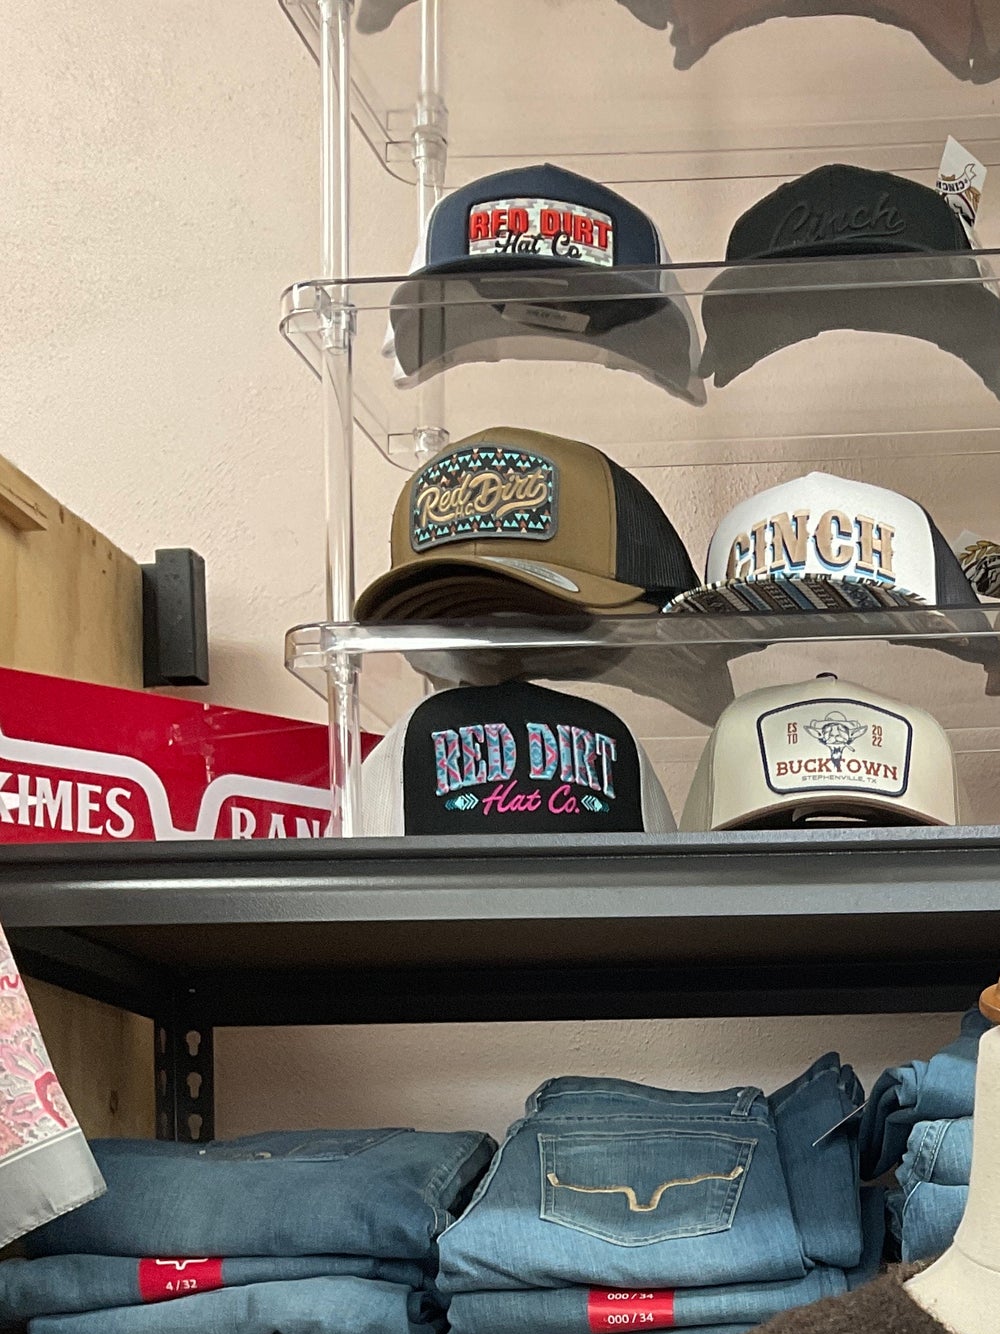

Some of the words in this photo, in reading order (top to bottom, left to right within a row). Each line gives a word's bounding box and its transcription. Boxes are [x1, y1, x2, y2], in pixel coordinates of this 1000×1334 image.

[470, 208, 529, 240] RED
[540, 208, 613, 249] DIRT
[495, 229, 545, 255] Hat
[417, 474, 472, 527] Red
[470, 468, 547, 517] Dirt
[726, 509, 895, 583] CINCH
[431, 723, 517, 797] RED
[525, 722, 617, 799] DIRT
[776, 757, 898, 781] BUCKTOWN
[482, 779, 542, 815] Hat
[547, 783, 581, 814] Co.
